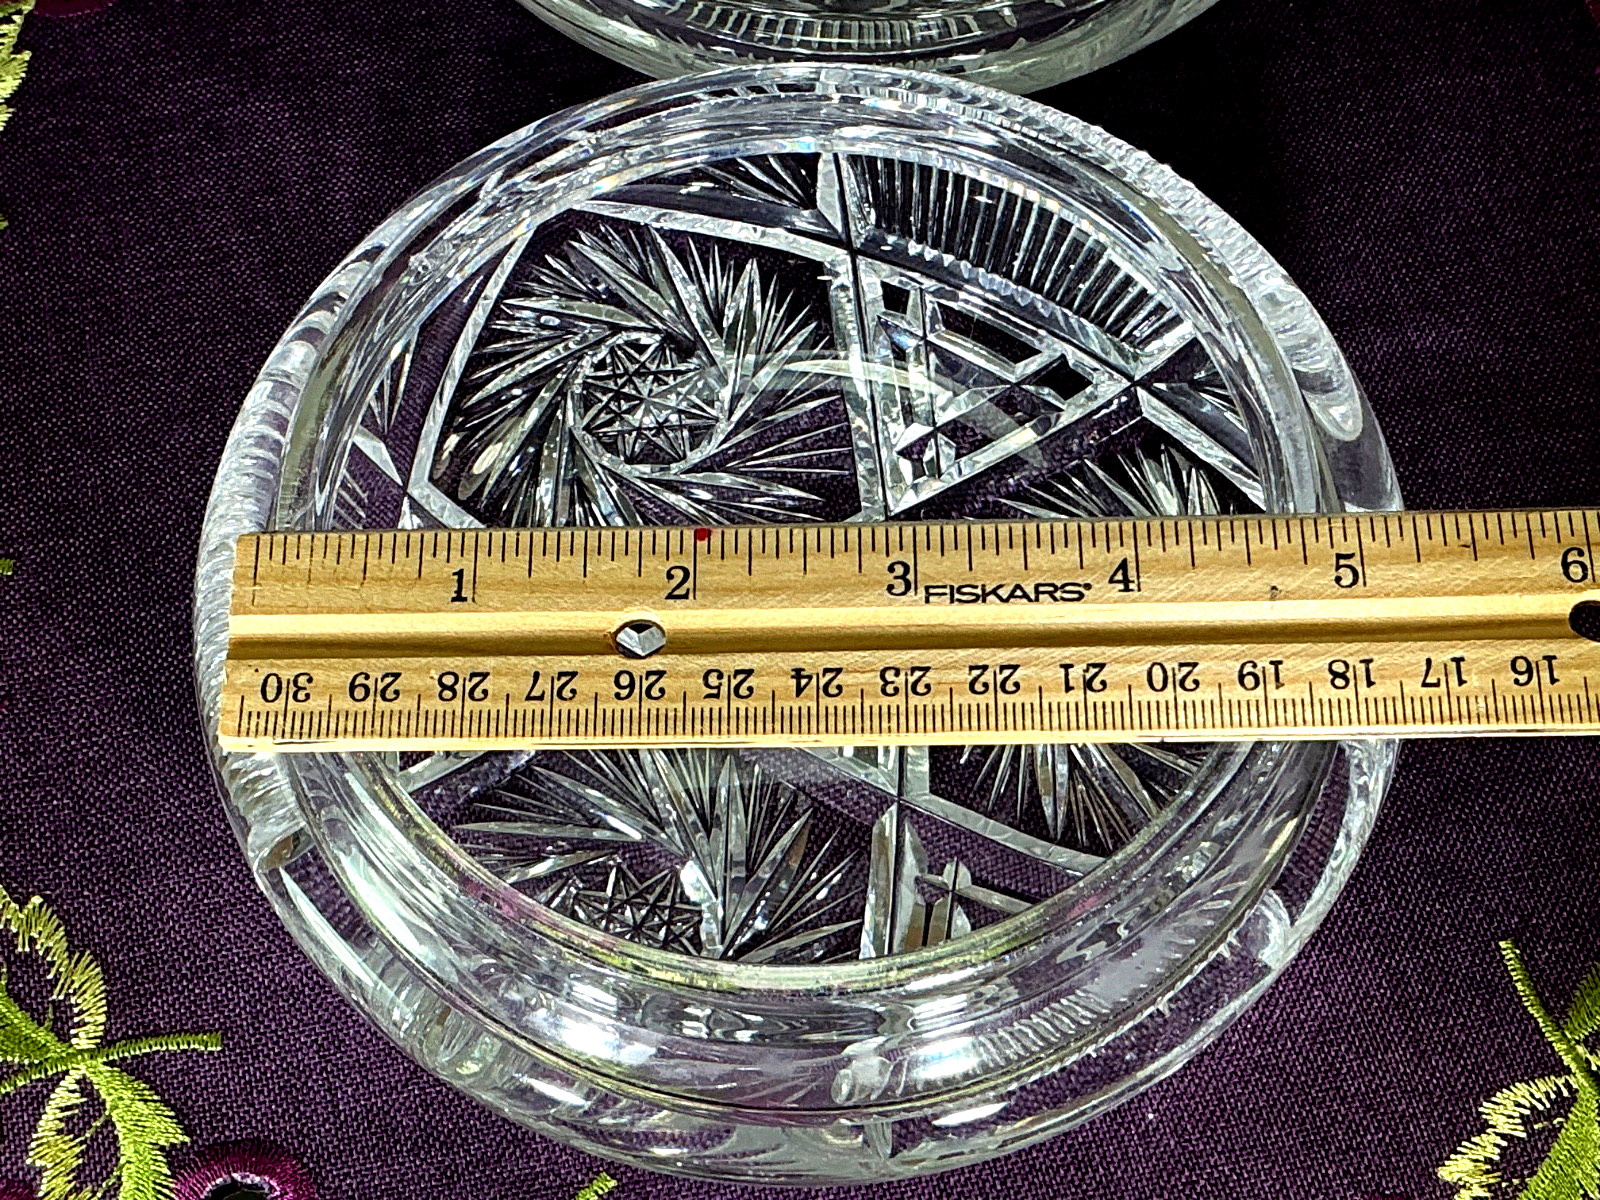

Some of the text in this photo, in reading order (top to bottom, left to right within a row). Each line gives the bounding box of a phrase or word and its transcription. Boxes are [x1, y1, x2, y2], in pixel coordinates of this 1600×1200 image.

[450, 546, 1589, 603] 1 2 3 4 5 6
[260, 655, 1560, 703] 16 17 18 19 20 21 22 23 24 25 26 27 28 29 30
